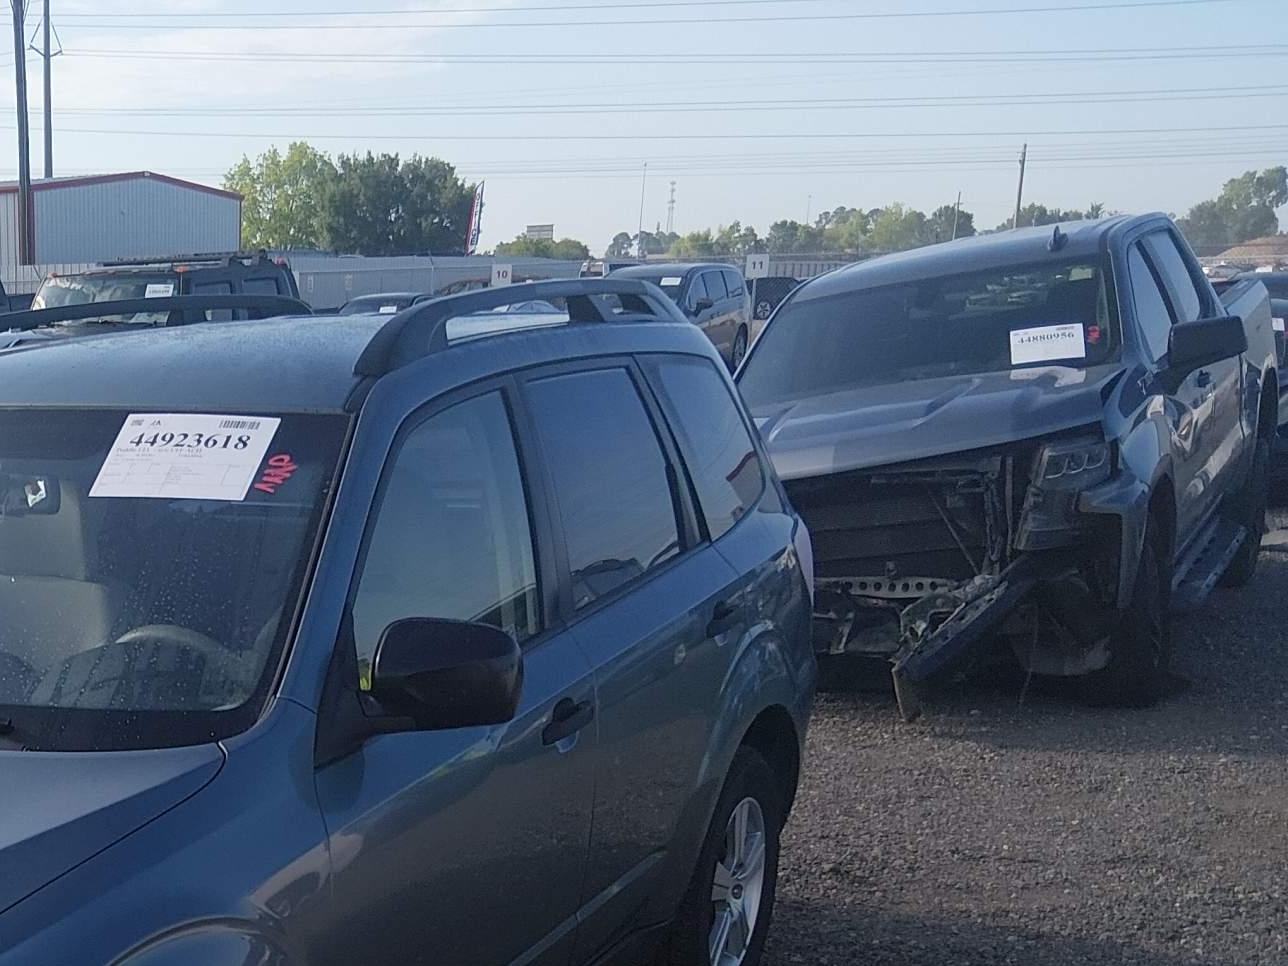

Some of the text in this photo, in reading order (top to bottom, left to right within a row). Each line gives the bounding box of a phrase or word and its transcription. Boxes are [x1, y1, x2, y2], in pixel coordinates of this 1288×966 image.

[752, 261, 763, 270] 11
[496, 270, 508, 279] 10
[129, 432, 251, 450] 44923618
